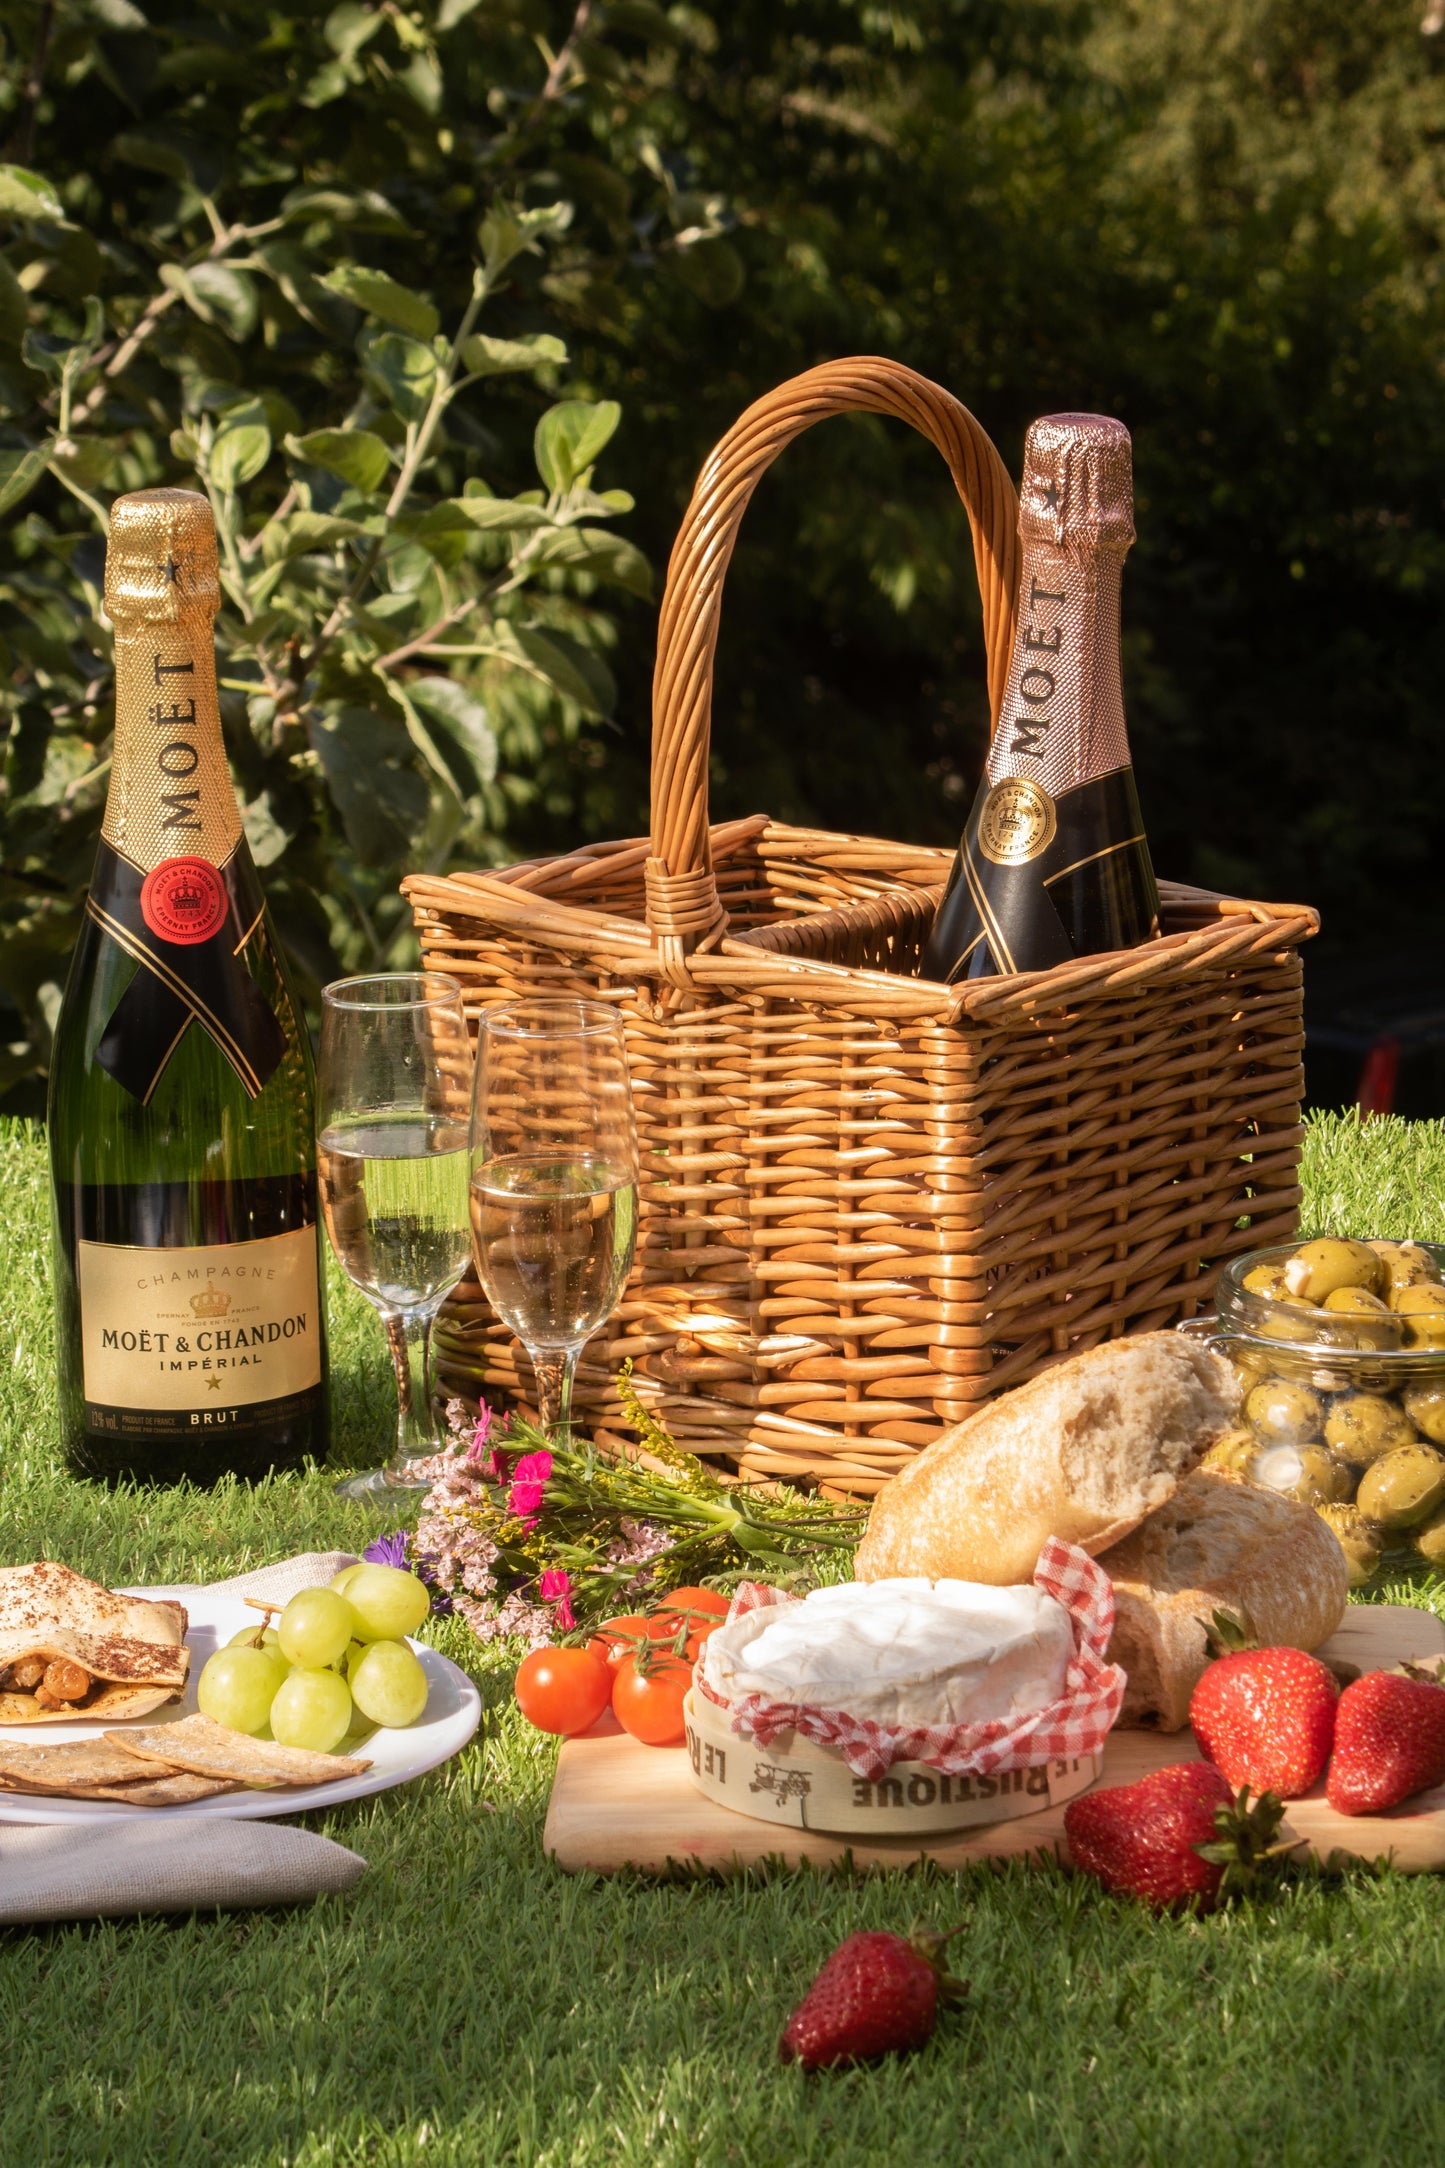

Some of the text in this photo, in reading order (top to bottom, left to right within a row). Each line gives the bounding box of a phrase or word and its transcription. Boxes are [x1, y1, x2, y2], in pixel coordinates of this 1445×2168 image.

[148, 653, 202, 831] MOËT
[1013, 790, 1043, 819] CHANDON
[179, 868, 216, 893] CHANDON
[174, 909, 202, 918] 1743
[192, 903, 217, 930] FRANCE
[137, 1266, 276, 1290] CHAMPAGNE
[231, 1305, 260, 1314] FRANCE
[102, 1313, 307, 1353] MOËT & CHANDON
[160, 1354, 262, 1371] IMPÉRIAL
[190, 1410, 239, 1425] BRUT
[704, 1742, 726, 1785] LE
